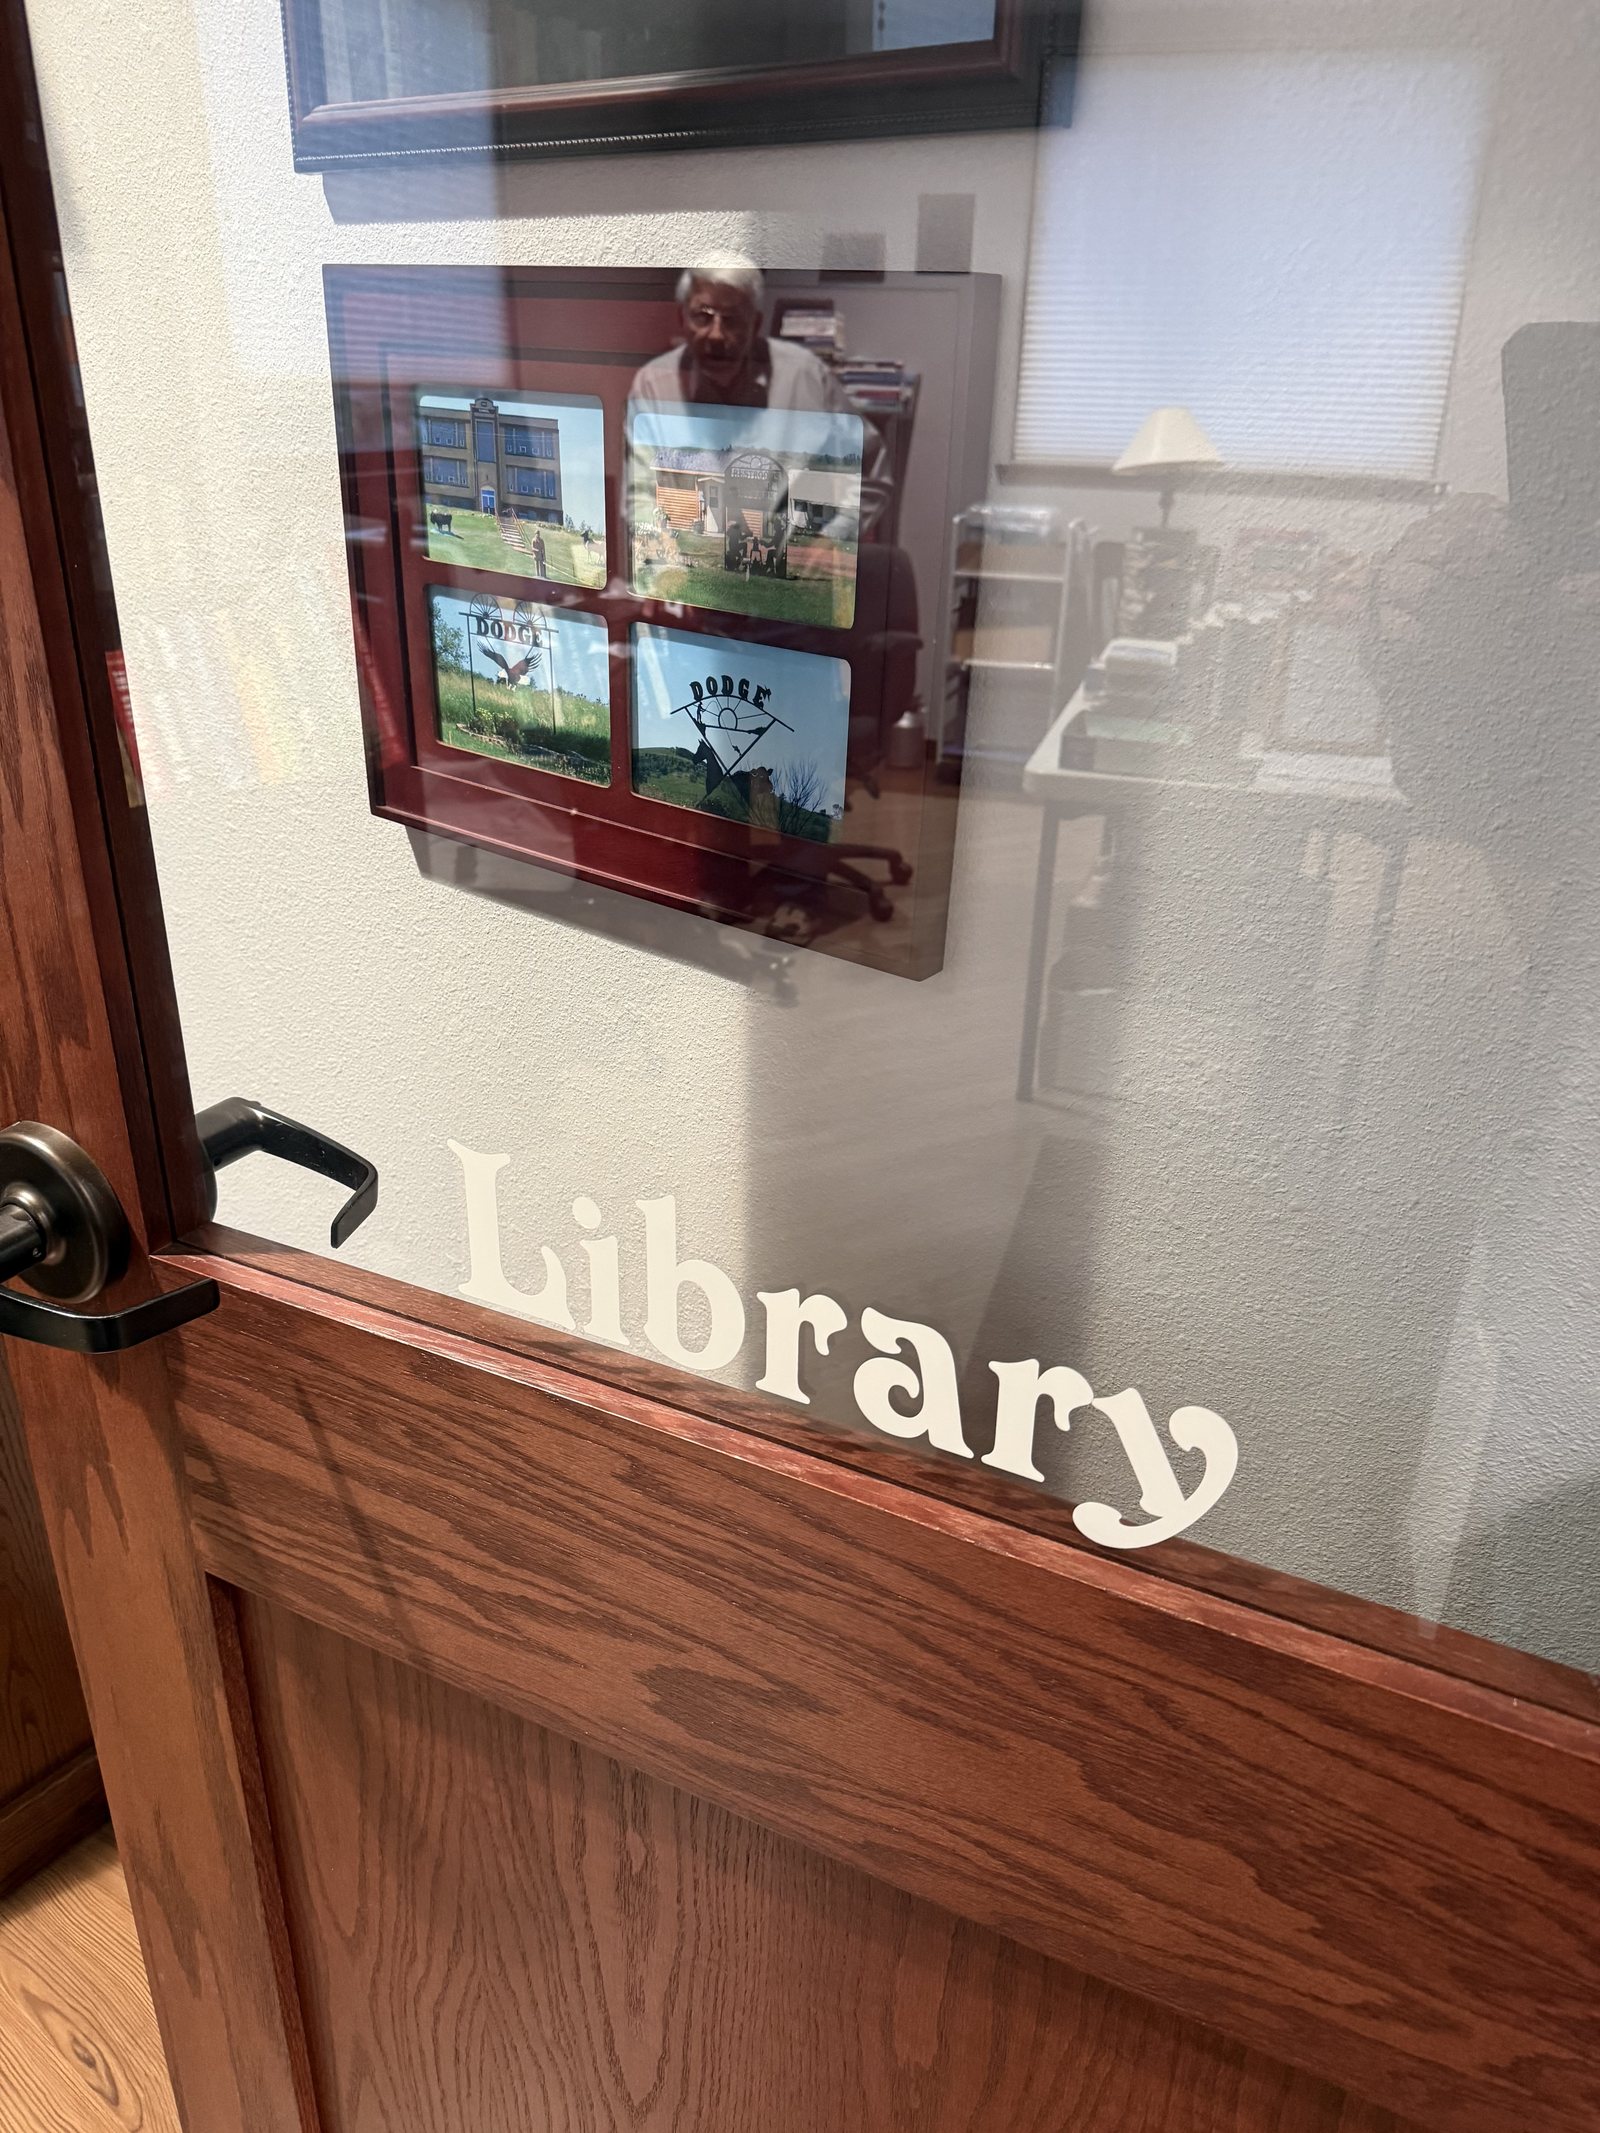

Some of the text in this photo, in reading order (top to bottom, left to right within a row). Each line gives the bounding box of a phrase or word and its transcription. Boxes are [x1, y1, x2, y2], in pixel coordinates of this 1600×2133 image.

[476, 616, 544, 648] DODGE
[689, 674, 771, 710] DODGE
[446, 1138, 1239, 1549] Library
